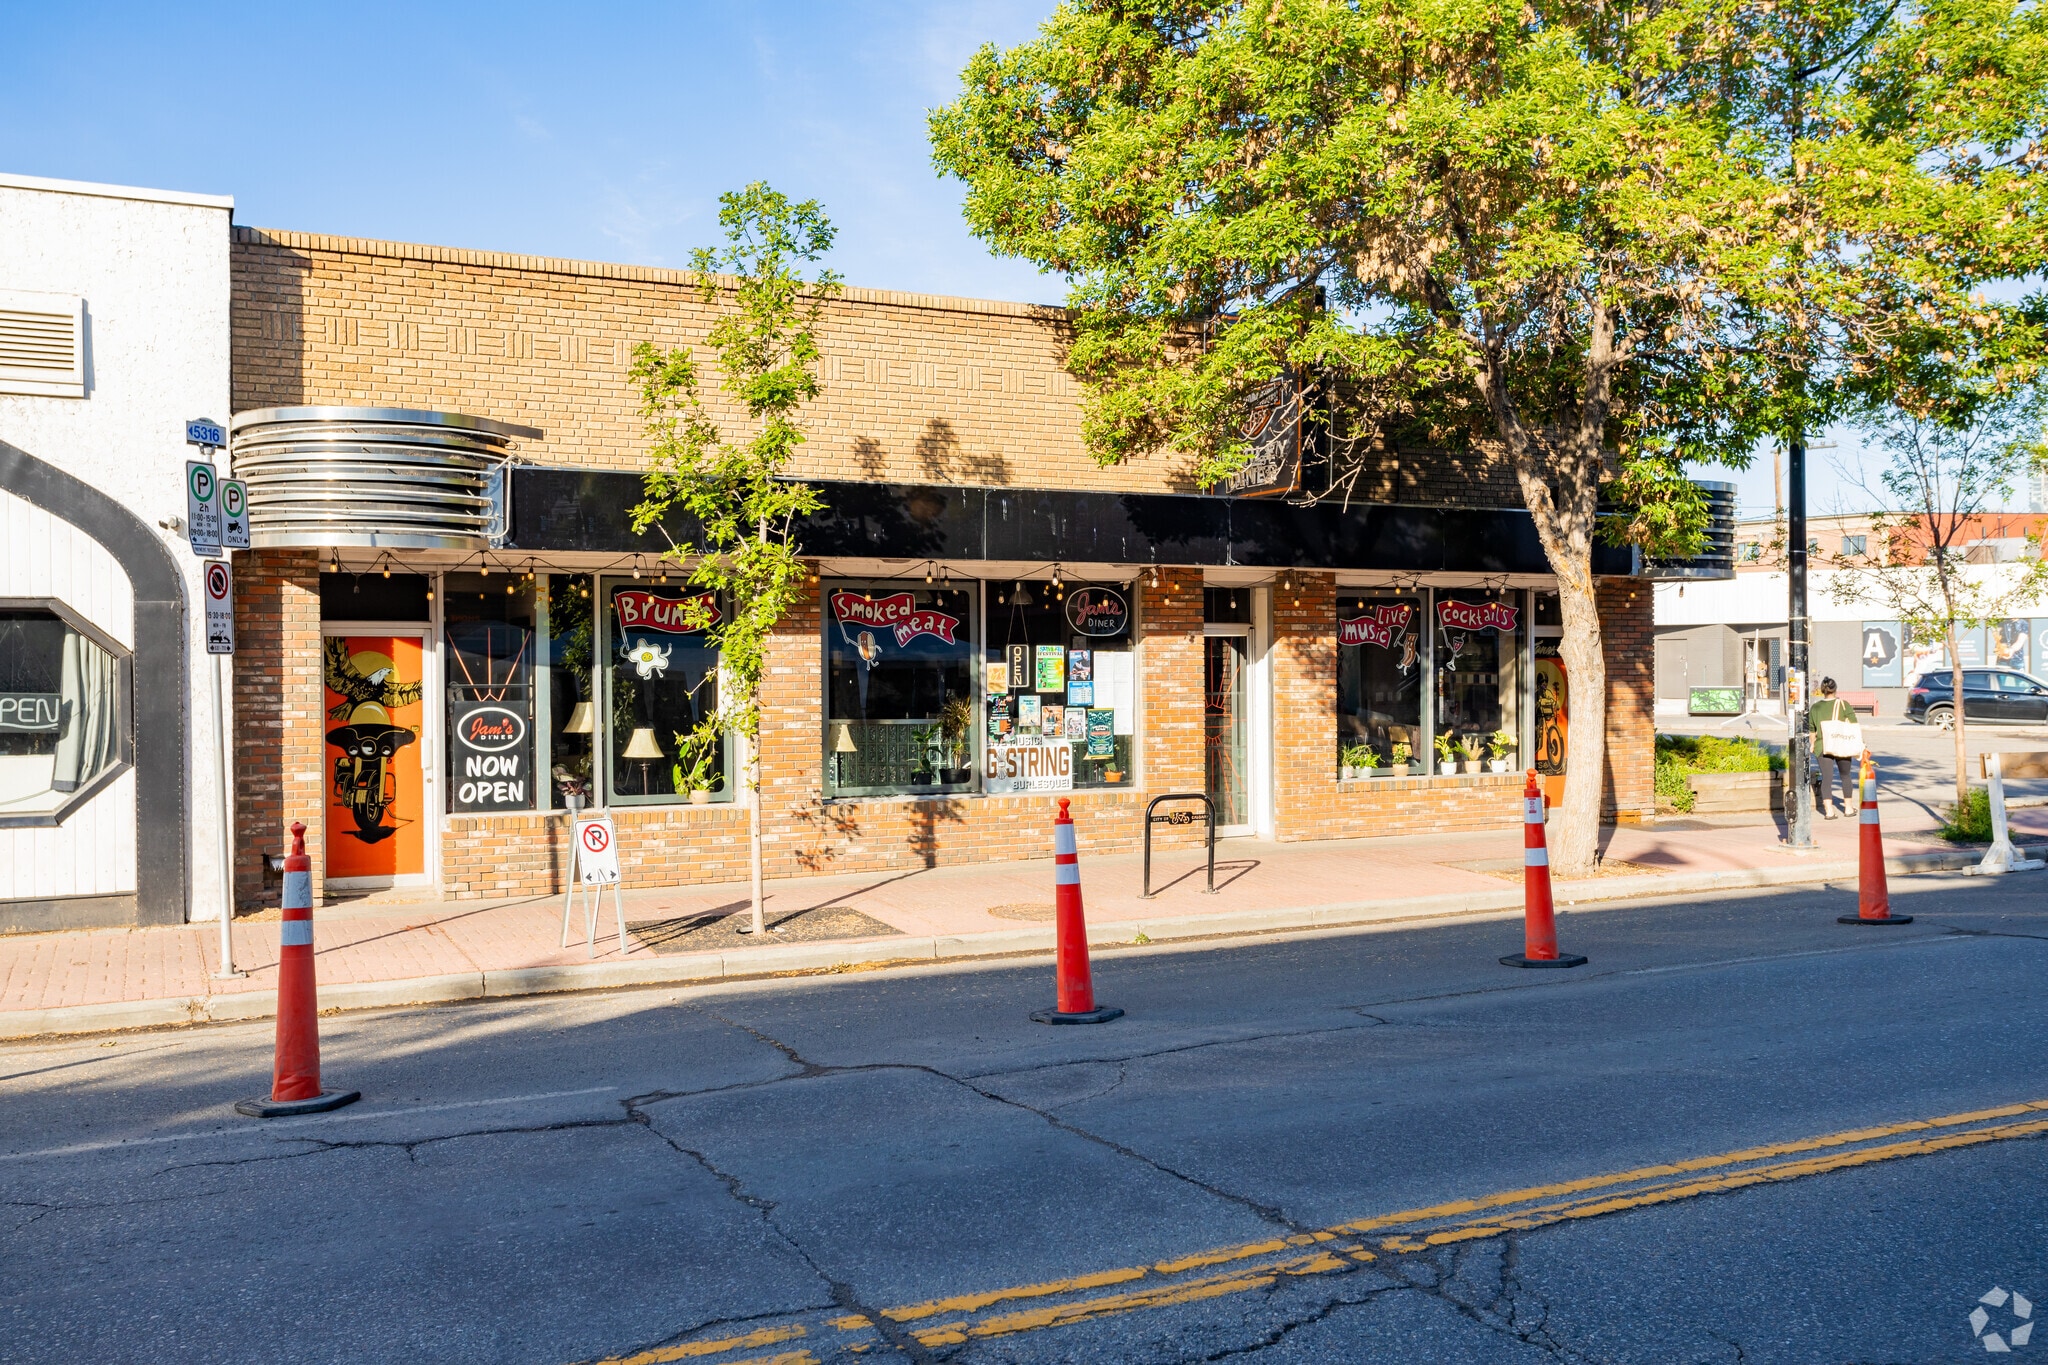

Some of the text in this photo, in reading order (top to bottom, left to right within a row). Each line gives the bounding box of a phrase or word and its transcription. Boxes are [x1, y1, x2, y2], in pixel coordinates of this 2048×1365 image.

[193, 425, 220, 442] 5316
[838, 597, 910, 622] Smoked
[897, 615, 947, 643] meat
[1088, 618, 1115, 628] DINER
[1013, 646, 1022, 685] OPEN
[469, 716, 514, 741] Jam's
[466, 755, 518, 777] NOW
[459, 779, 524, 804] OPEN
[1013, 778, 1070, 790] BURLESQUE!
